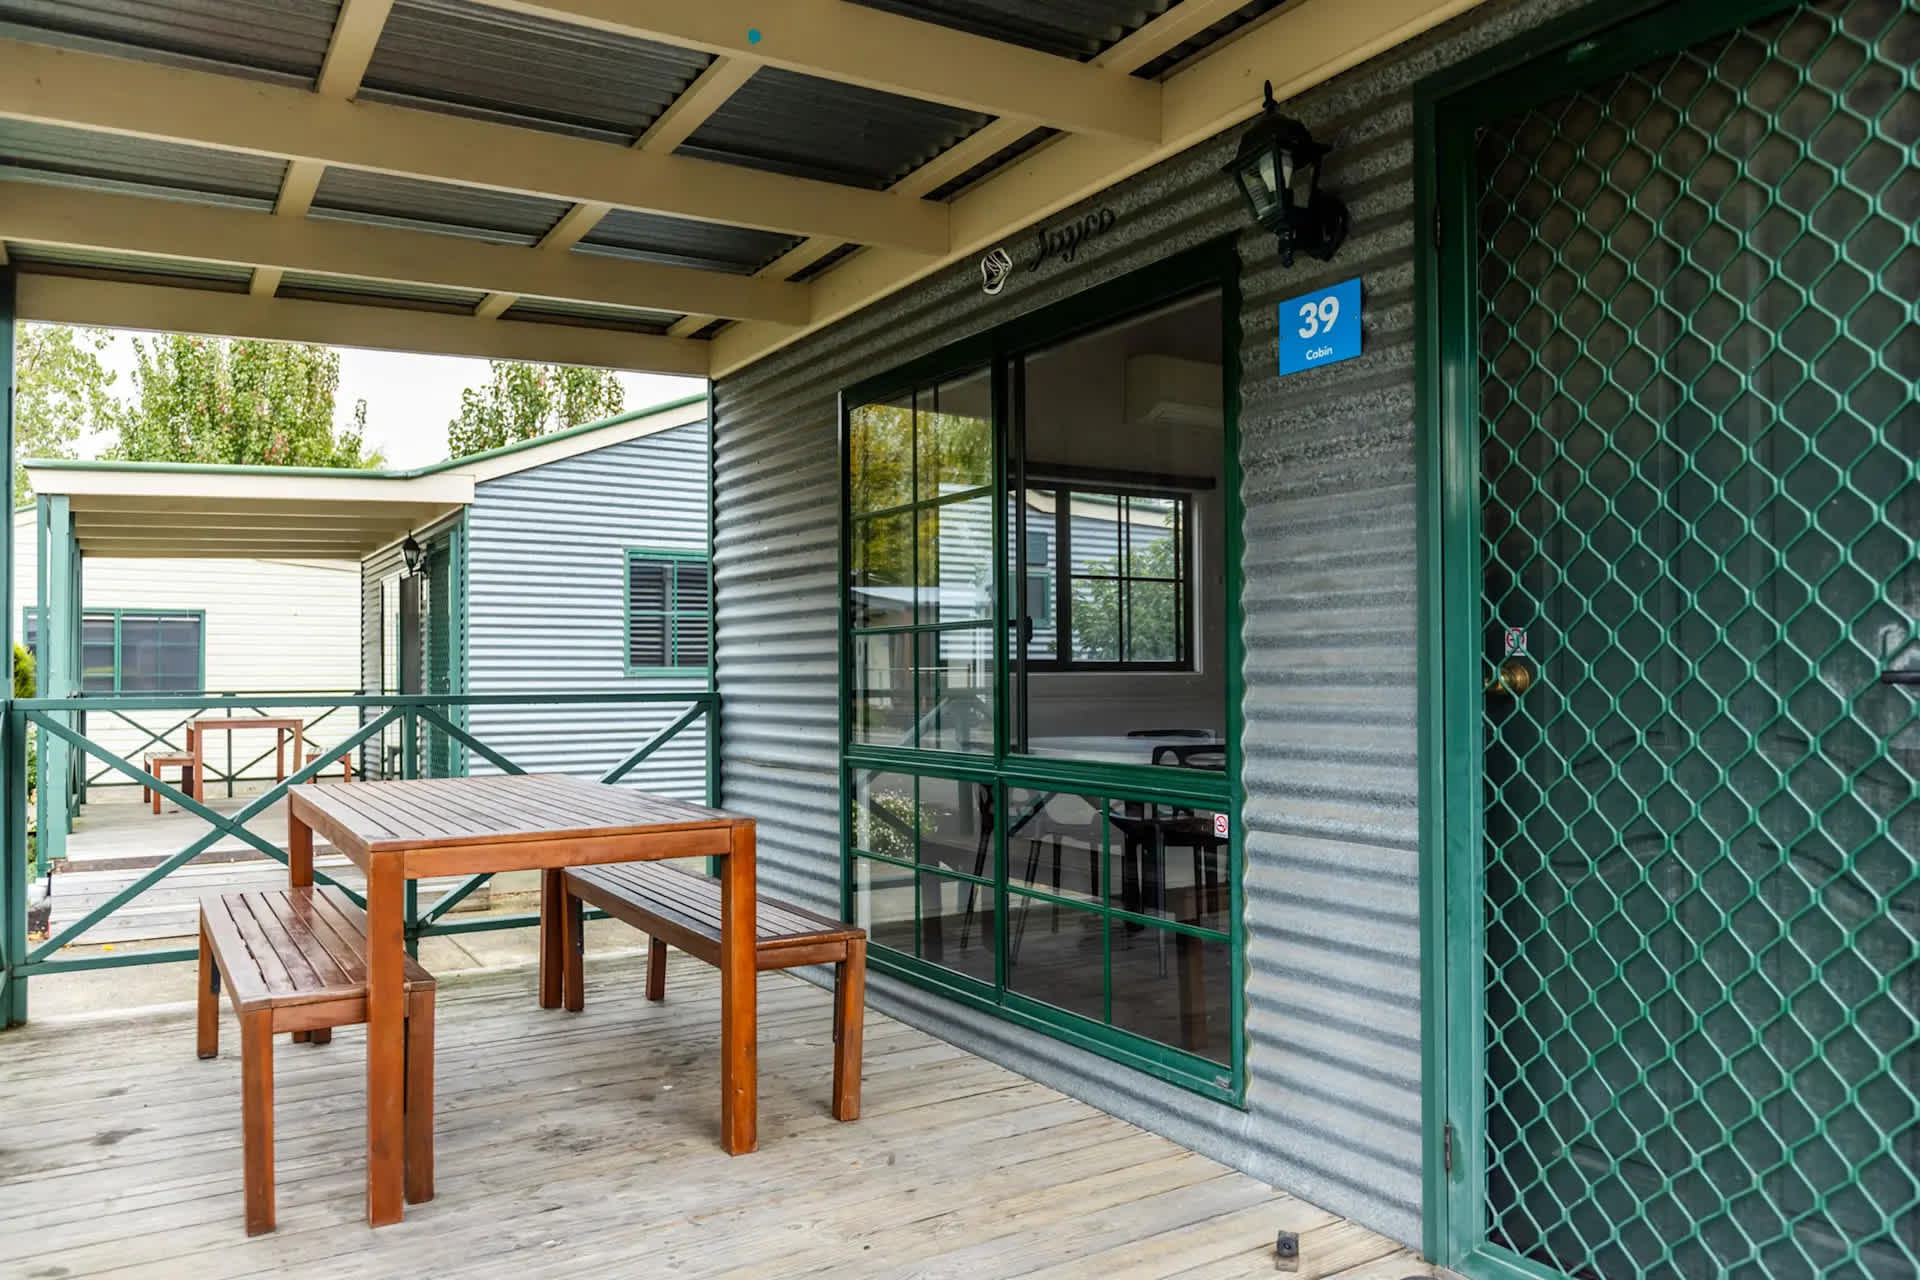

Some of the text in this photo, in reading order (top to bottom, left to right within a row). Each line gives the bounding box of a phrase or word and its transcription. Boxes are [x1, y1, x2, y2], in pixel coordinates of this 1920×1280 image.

[1028, 208, 1115, 272] Jayco
[1298, 296, 1340, 339] 39
[1305, 345, 1334, 361] Cabin
